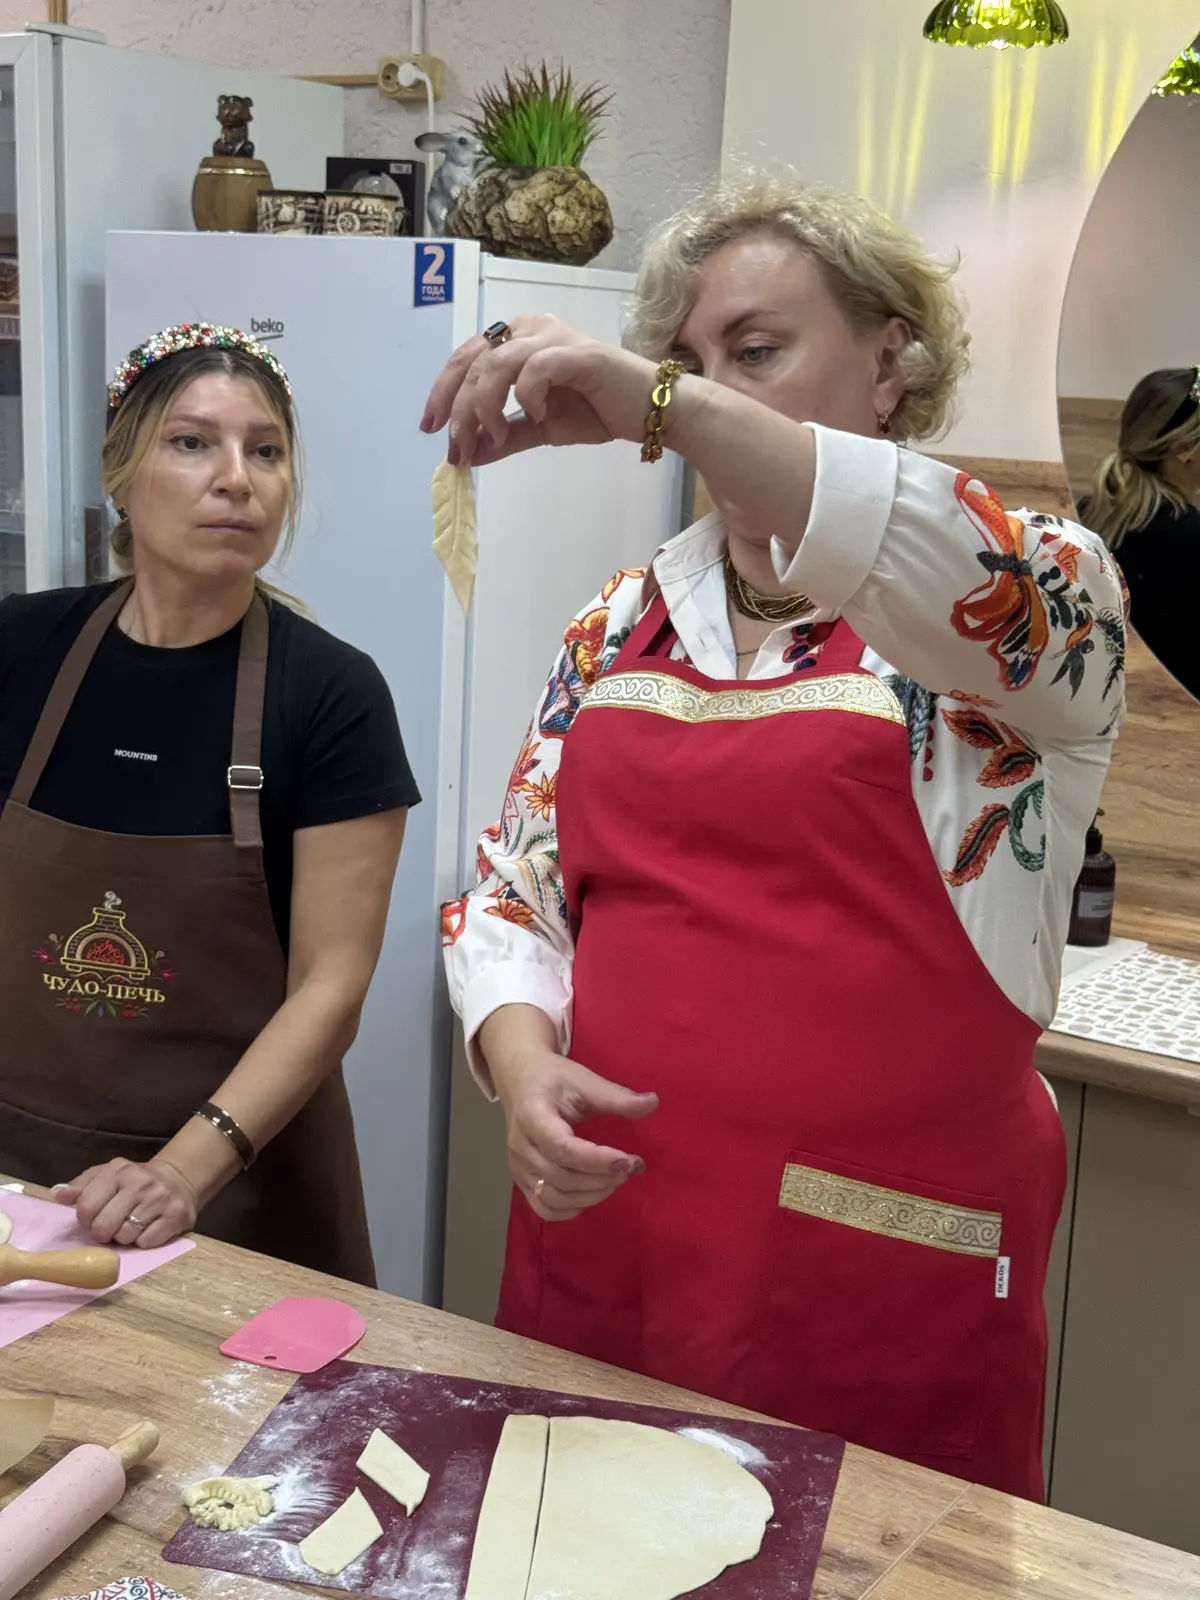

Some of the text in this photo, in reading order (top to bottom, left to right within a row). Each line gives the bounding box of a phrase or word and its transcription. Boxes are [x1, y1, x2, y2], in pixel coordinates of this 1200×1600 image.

[422, 245, 446, 285] 2
[422, 285, 446, 297] ГОДА
[251, 316, 285, 333] beko
[114, 748, 158, 761] MOUNTINS
[42, 973, 167, 1003] ЧУДО-ПЕЧЬ
